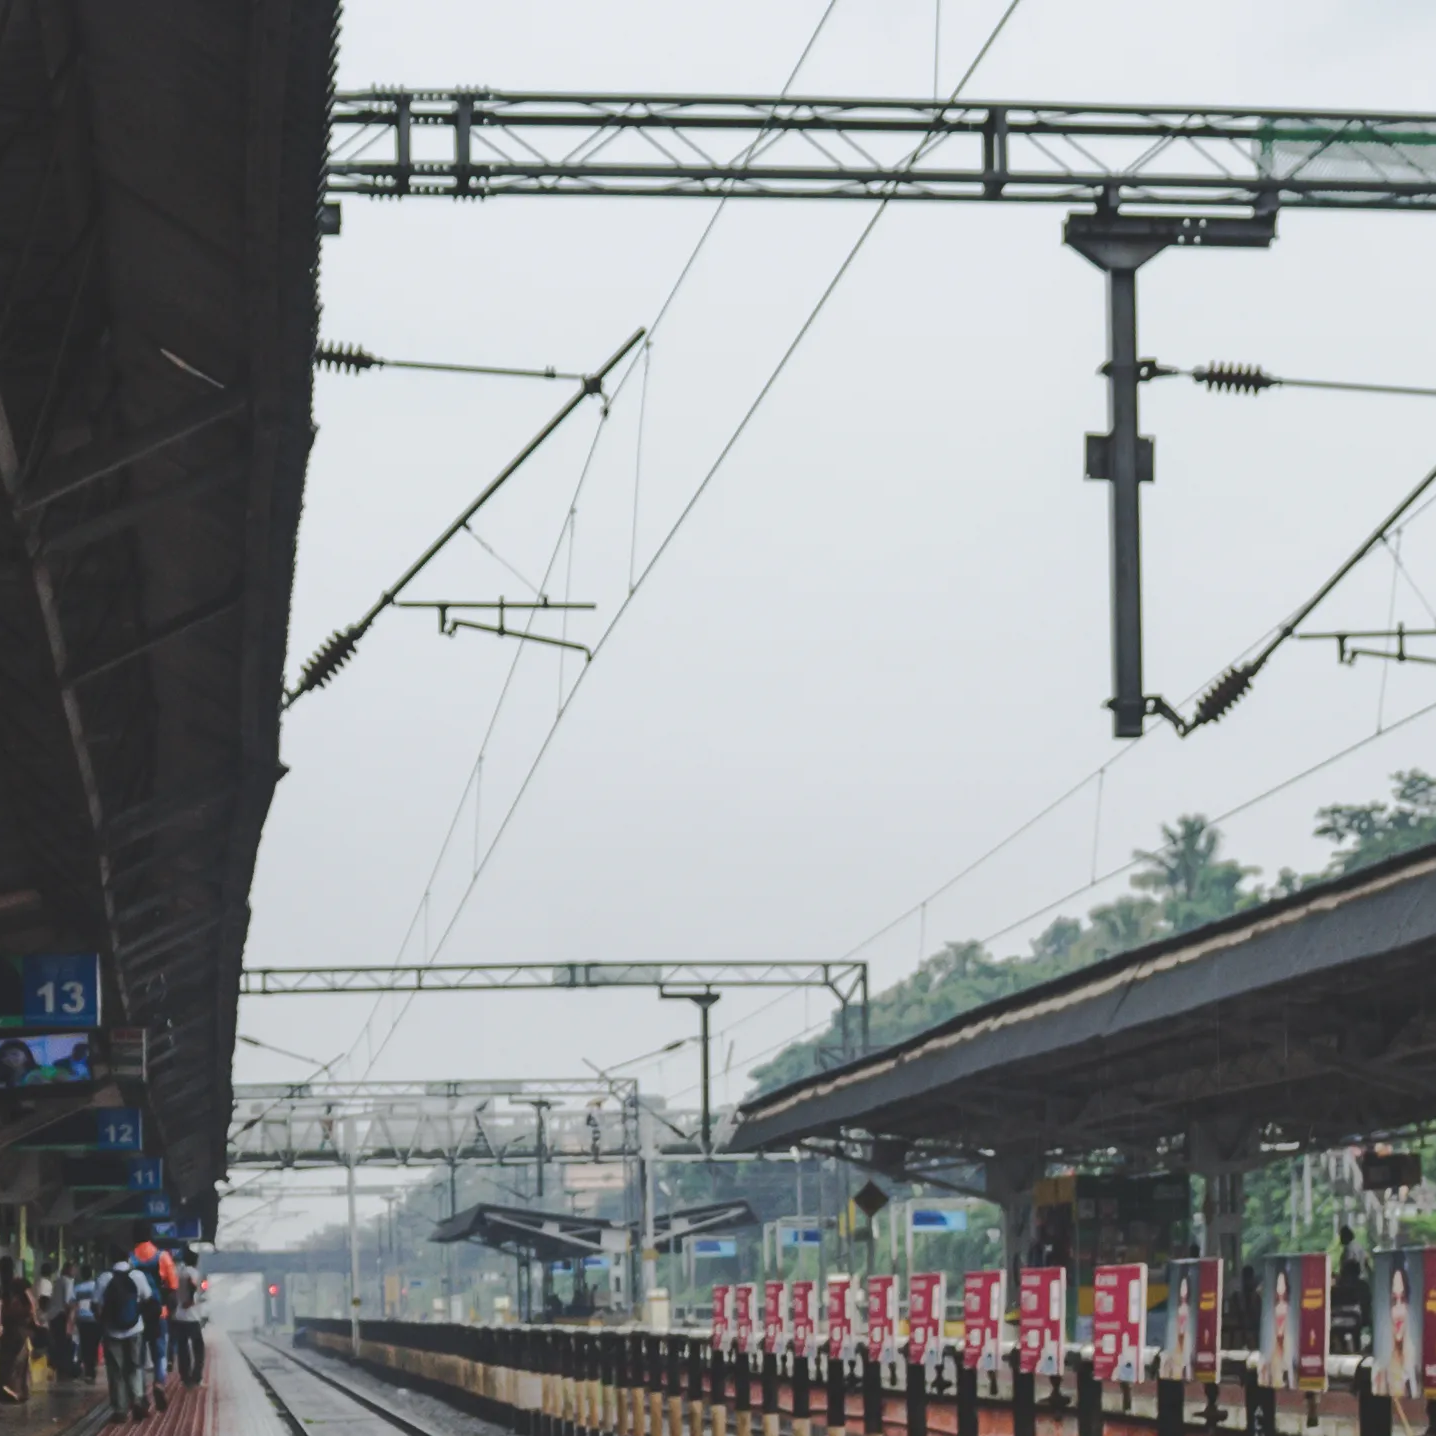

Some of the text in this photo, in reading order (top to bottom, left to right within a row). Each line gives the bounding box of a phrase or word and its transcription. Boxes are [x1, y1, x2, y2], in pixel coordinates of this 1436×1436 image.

[36, 981, 85, 1013] 13
[103, 1123, 134, 1144] 12
[132, 1168, 154, 1187] 11
